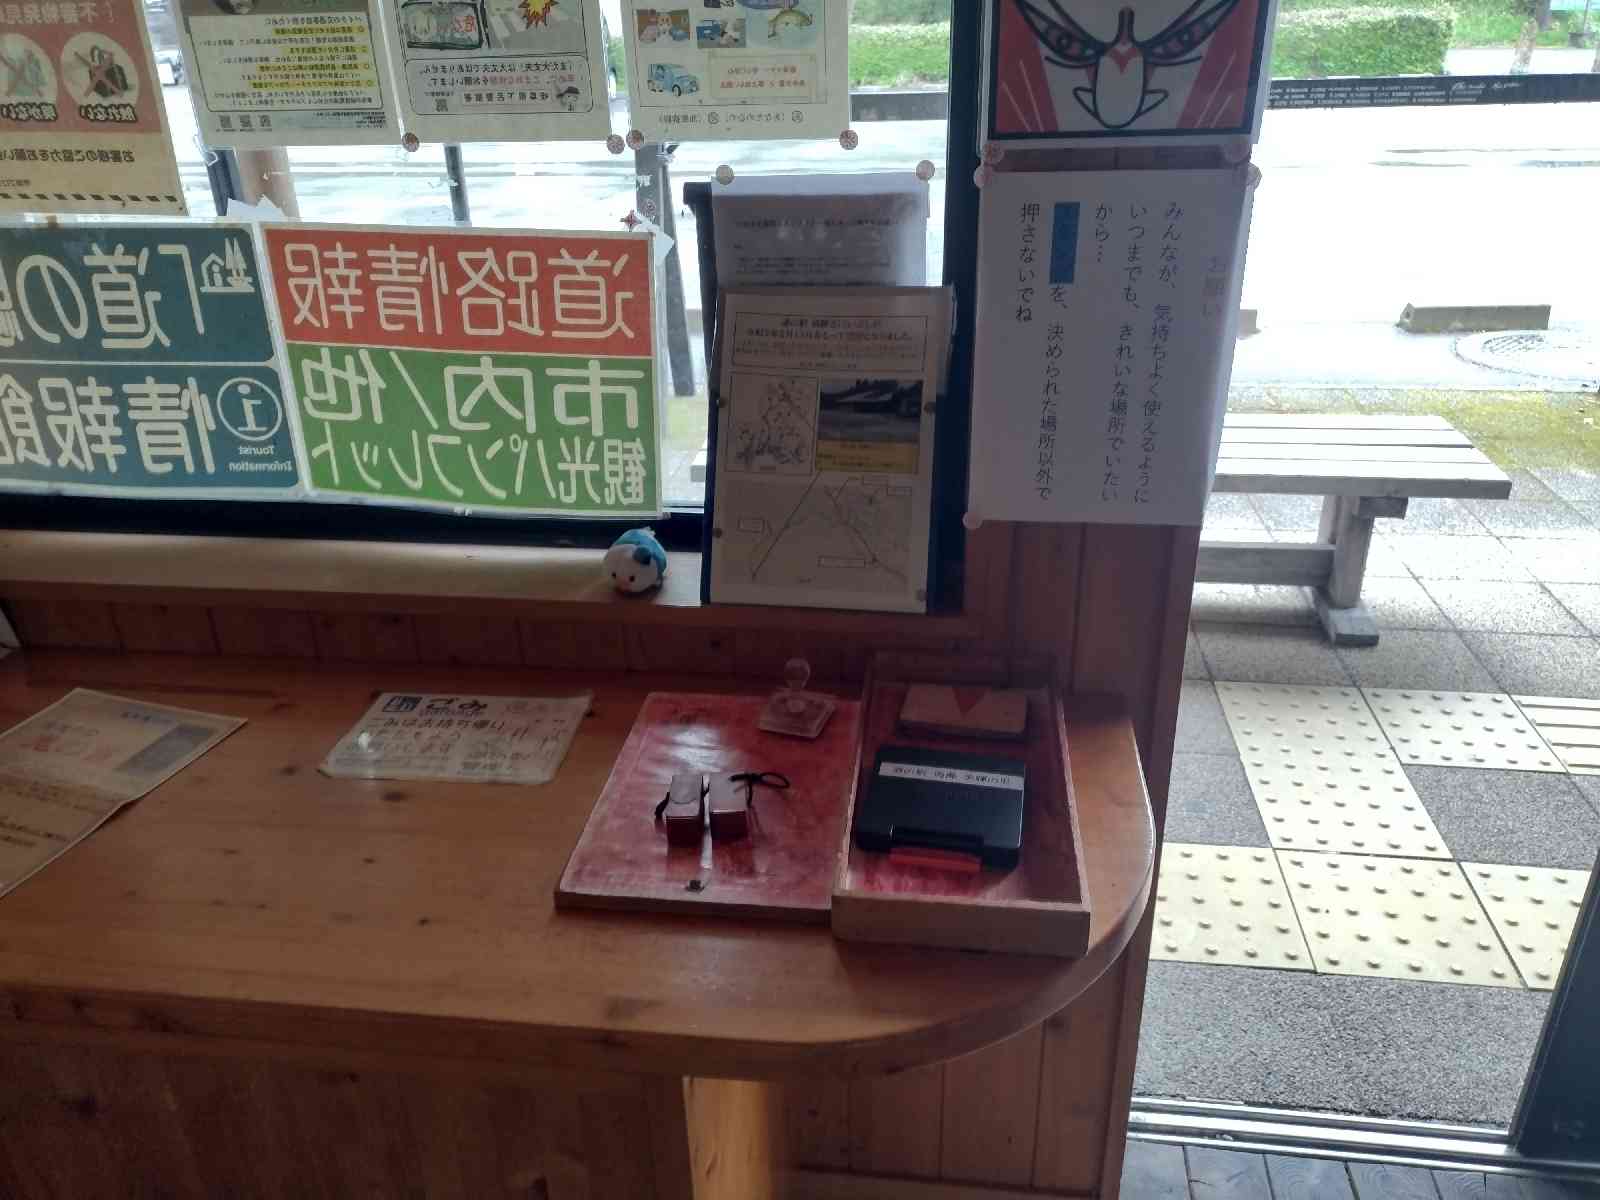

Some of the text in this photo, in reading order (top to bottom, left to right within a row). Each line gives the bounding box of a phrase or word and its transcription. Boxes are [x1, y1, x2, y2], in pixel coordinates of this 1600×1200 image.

[1015, 202, 1040, 322] 押さないでね
